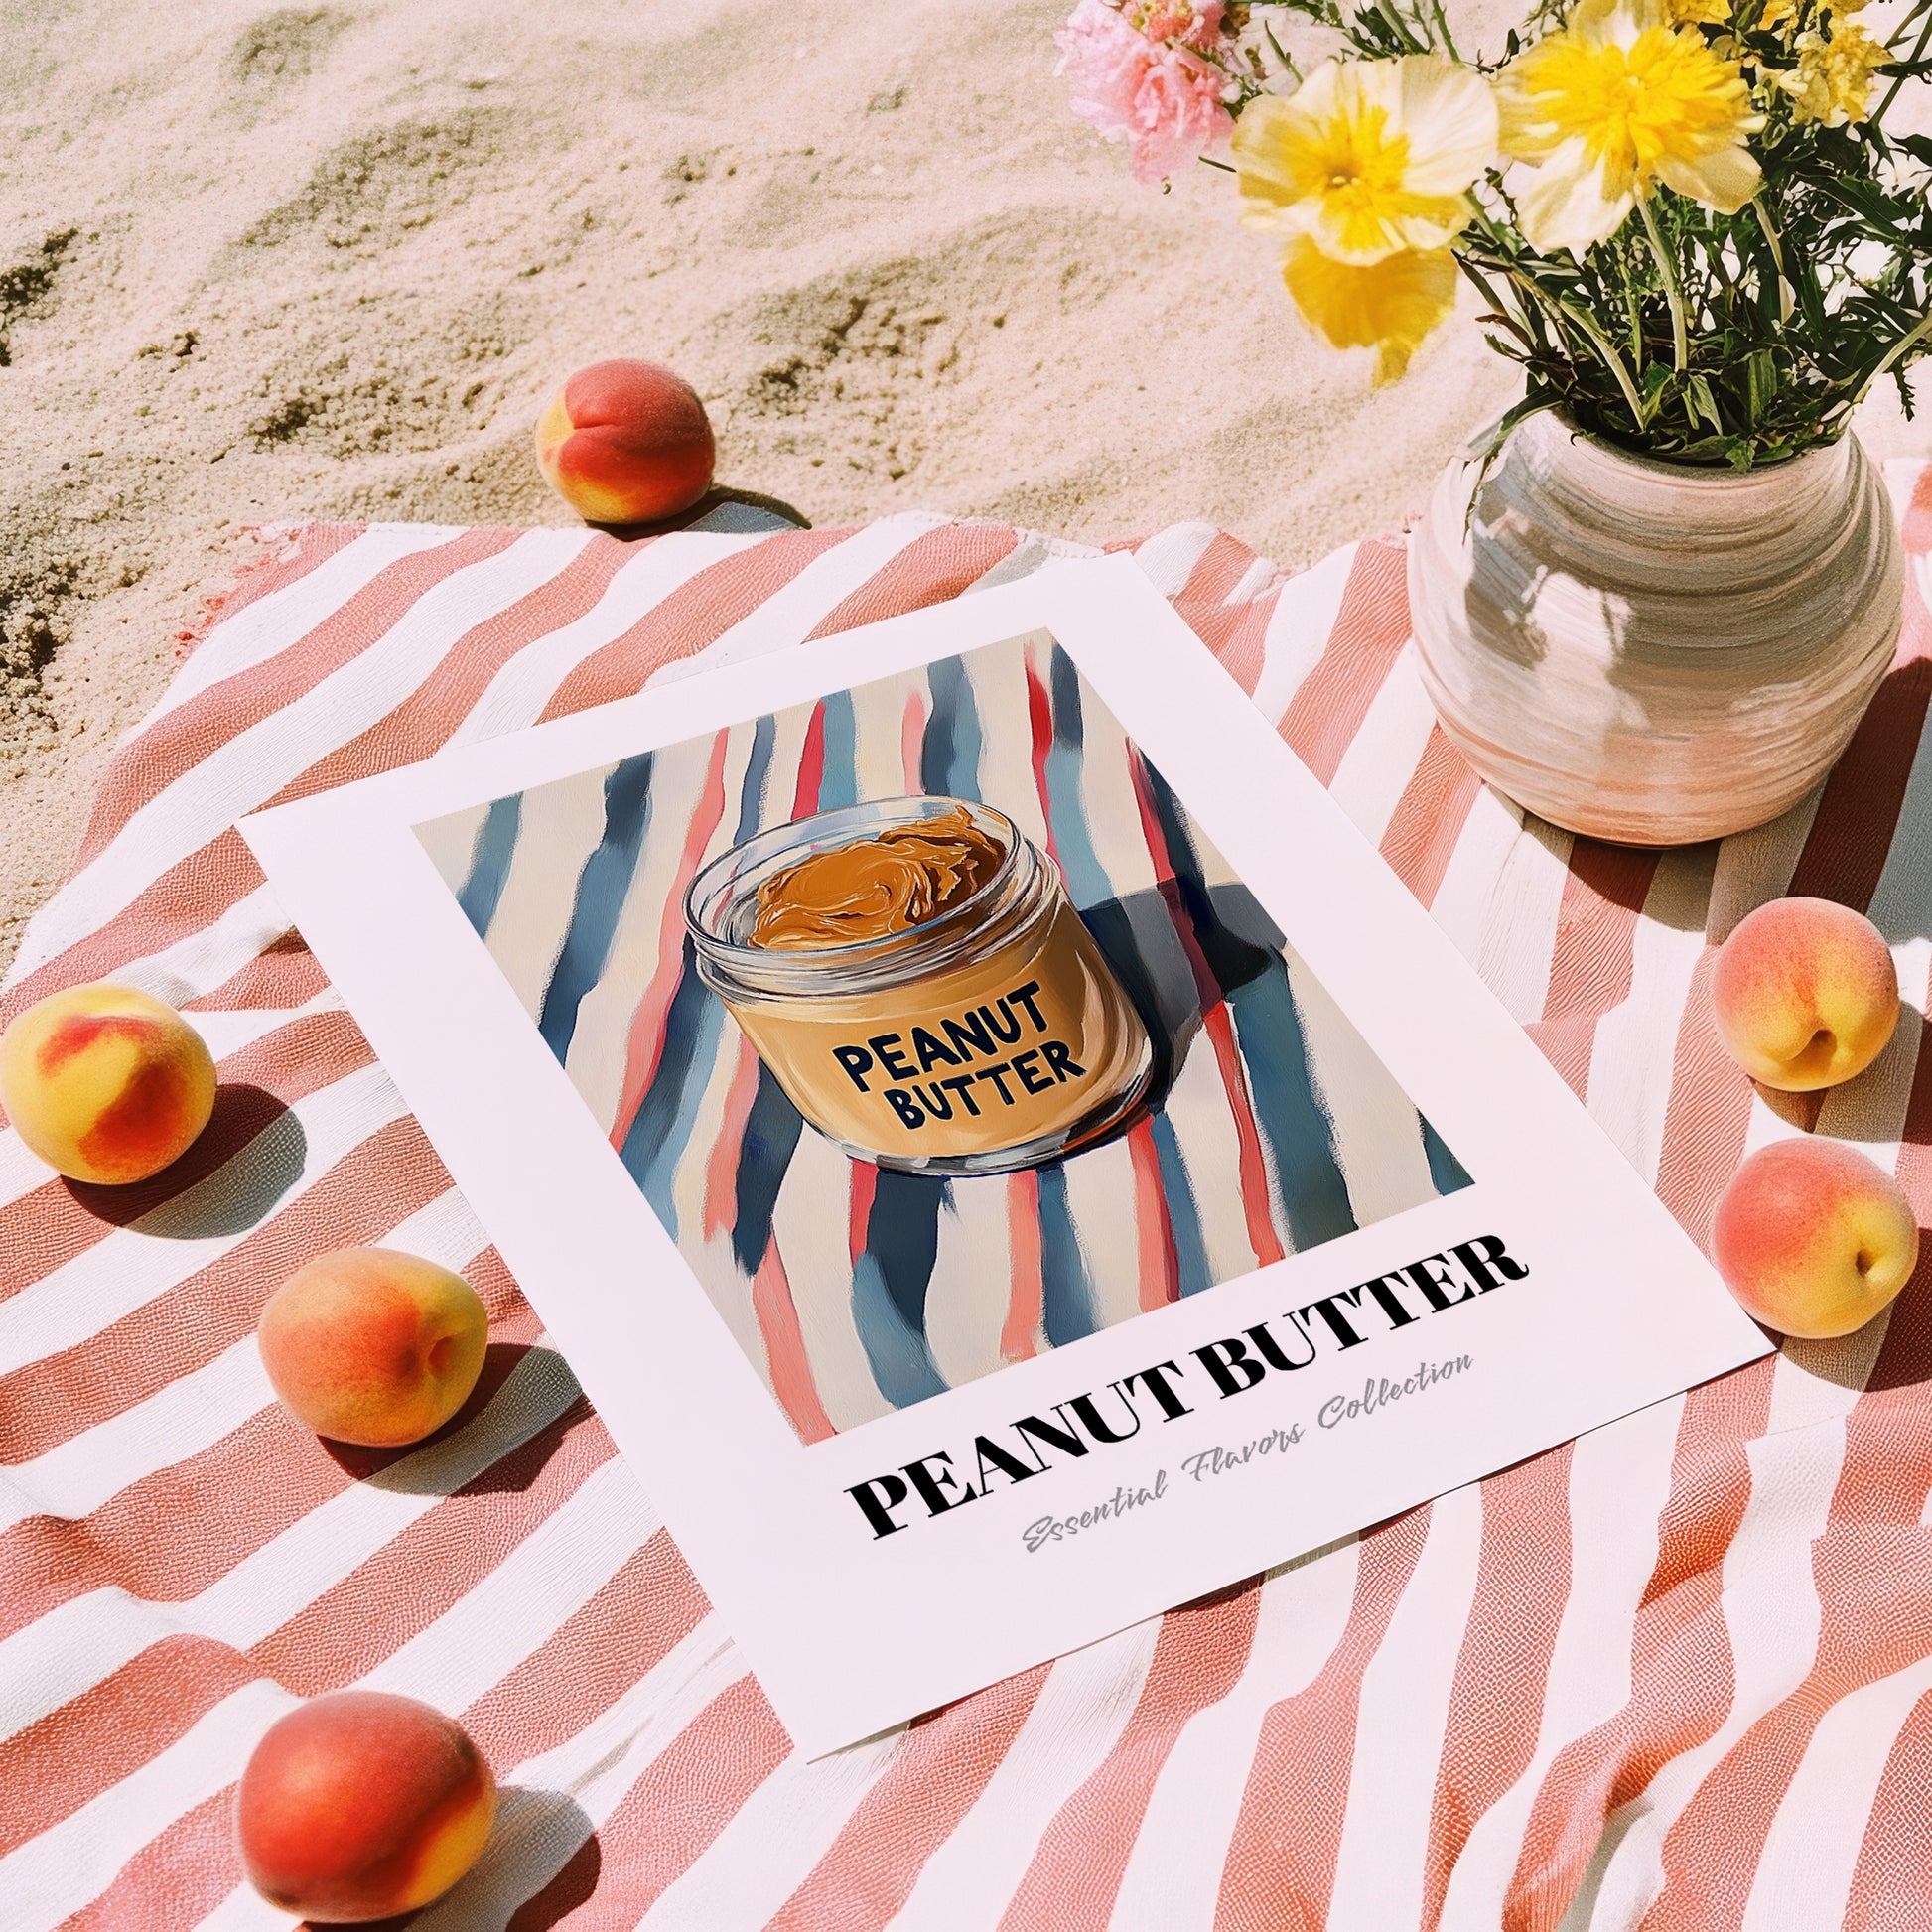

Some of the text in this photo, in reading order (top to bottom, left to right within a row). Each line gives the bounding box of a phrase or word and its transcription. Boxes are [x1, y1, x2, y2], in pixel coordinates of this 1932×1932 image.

[832, 980, 1048, 1092] PEANUT
[883, 1040, 1088, 1130] BUTTER
[843, 1235, 1529, 1540] PEANUT BUTTER
[1023, 1355, 1473, 1553] Essential Flavors Collection
